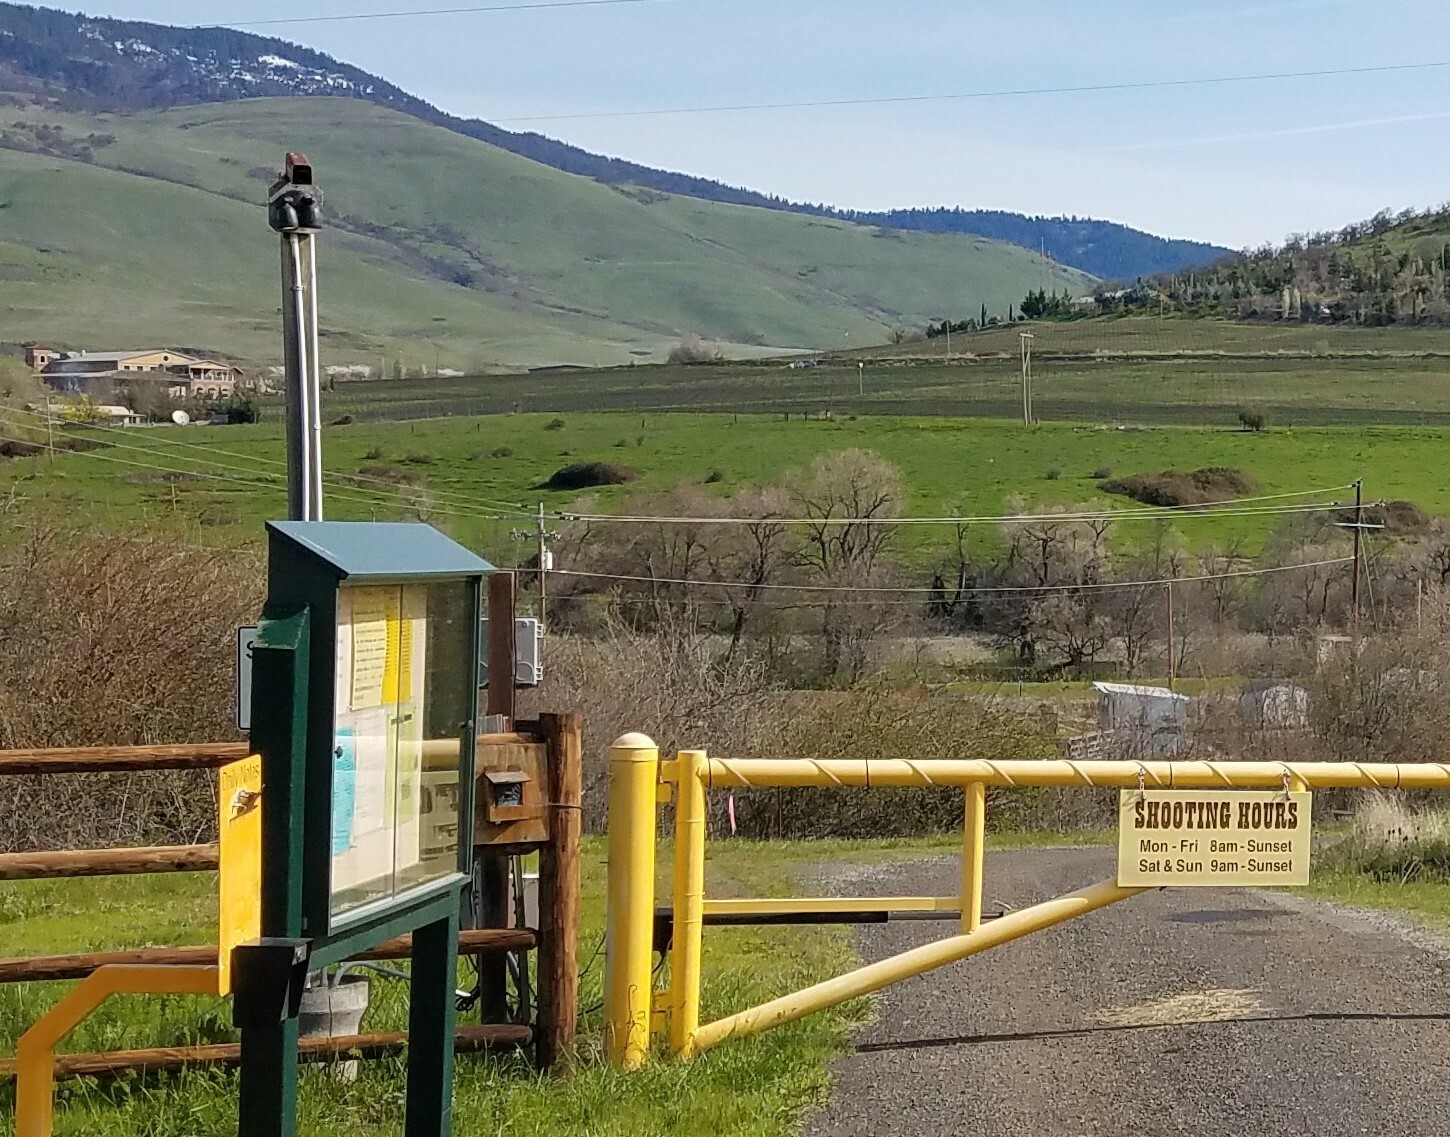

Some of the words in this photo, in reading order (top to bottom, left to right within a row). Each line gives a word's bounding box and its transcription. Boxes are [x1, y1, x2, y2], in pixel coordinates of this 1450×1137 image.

[1134, 801, 1231, 829] SHOOTING
[1237, 802, 1298, 829] HOURS
[1140, 839, 1168, 852] Mon
[1180, 839, 1198, 852] Fri
[1210, 839, 1238, 853] 8am
[1247, 839, 1292, 853] Sunset
[1139, 859, 1160, 872] Sat
[1163, 859, 1173, 872] &
[1175, 859, 1203, 872] Sun
[1210, 859, 1238, 872] 9am
[1247, 859, 1292, 872] Sunset
